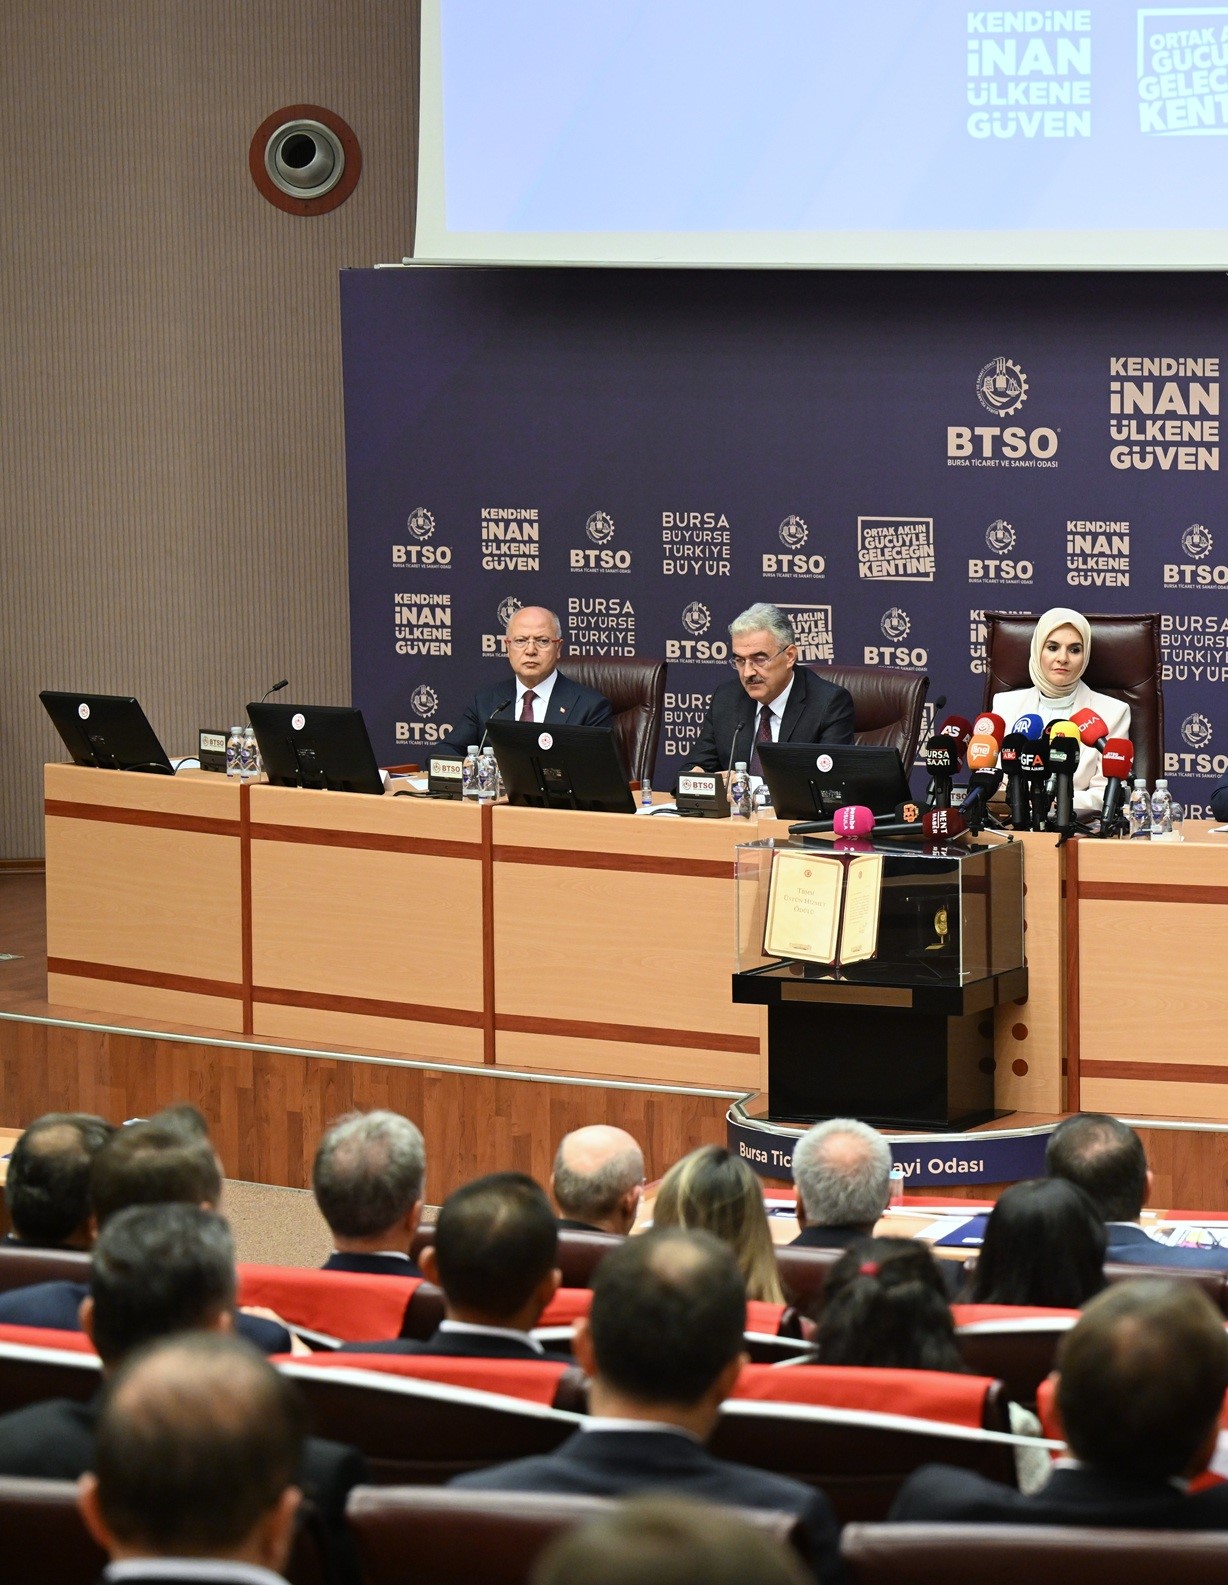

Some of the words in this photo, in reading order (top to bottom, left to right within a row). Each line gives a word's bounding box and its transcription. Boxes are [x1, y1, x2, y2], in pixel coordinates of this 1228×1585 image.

[1149, 27, 1216, 51] ORTAK
[967, 82, 1091, 106] ÜLKENE
[967, 111, 1091, 139] GÜVEN
[1110, 420, 1219, 442] ÜLKENE
[948, 427, 1060, 459] BTSO
[971, 459, 998, 467] TİCARET
[1011, 459, 1036, 467] SANAYİ
[1110, 446, 1219, 471] GÜVEN
[663, 512, 729, 528] BURSA
[663, 530, 730, 543] BÜYÜRSE
[864, 527, 895, 537] ORTAK
[898, 524, 926, 534] AKLIN
[393, 546, 451, 564] BTSO
[482, 542, 539, 555] ÜLKENE
[663, 545, 730, 558] TÜRKİYE
[482, 556, 539, 571] GÜVEN
[570, 550, 631, 568] BTSO
[763, 554, 825, 573] BTSO
[1067, 557, 1129, 570] ÜLKENE
[664, 560, 730, 576] BÜYÜR
[969, 560, 1033, 579] BTSO
[1067, 572, 1129, 587] GÜVEN
[569, 598, 634, 614] BURSA
[569, 616, 635, 629] BÜYÜRSE
[797, 612, 825, 622] AKLIN
[396, 627, 451, 640] ÜLKENE
[569, 630, 635, 644] TÜRKİYE
[396, 641, 452, 656] GÜVEN
[666, 640, 727, 659] BTSO
[864, 647, 927, 666] BTSO
[941, 726, 960, 737] AS
[1021, 754, 1044, 766] GFA
[442, 765, 460, 773] BTSO
[940, 811, 948, 834] MENT
[739, 1142, 768, 1164] Bursa
[928, 1158, 984, 1175] Odası
